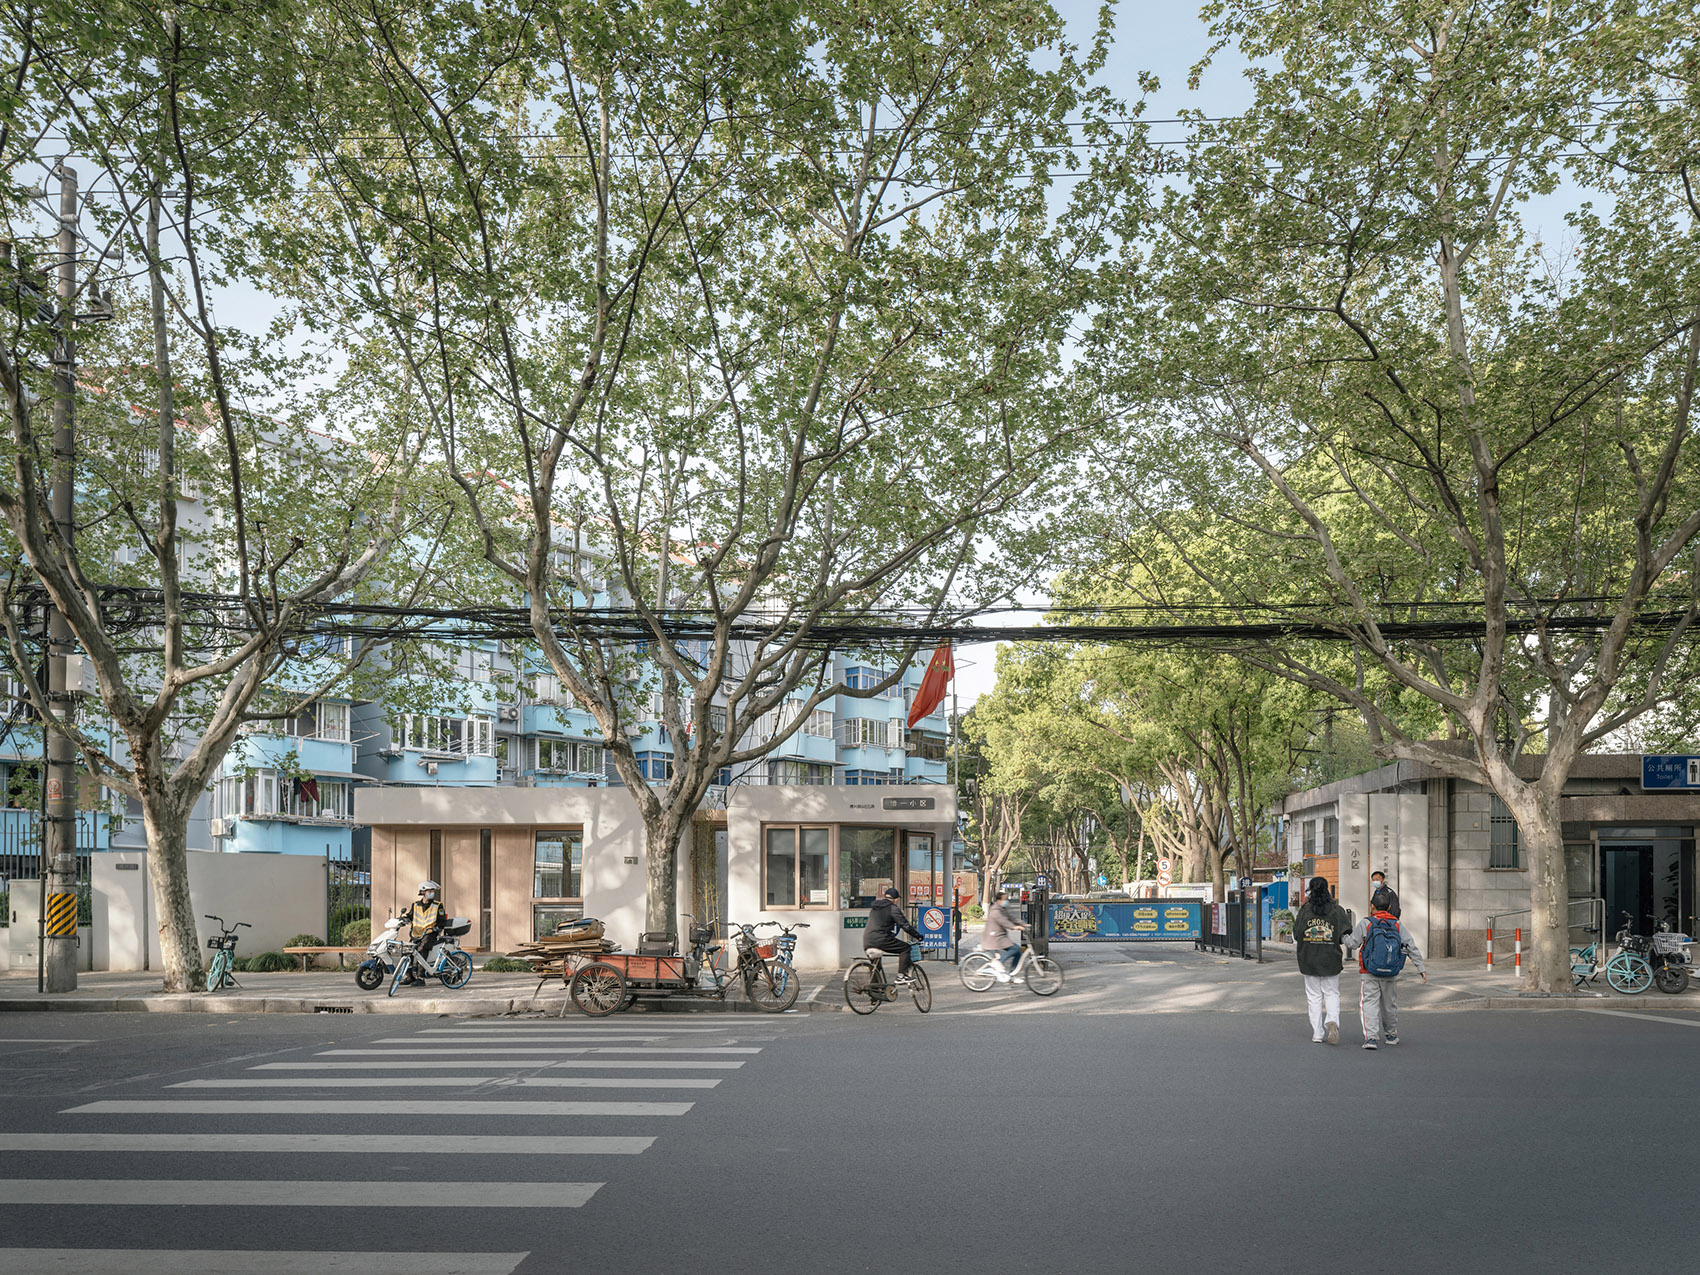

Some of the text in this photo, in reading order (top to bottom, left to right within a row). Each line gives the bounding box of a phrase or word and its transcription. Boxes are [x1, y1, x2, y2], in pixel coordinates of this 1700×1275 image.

[1647, 763, 1682, 772] 公共厕所
[1161, 861, 1168, 870] 5
[1038, 877, 1047, 886] 出
